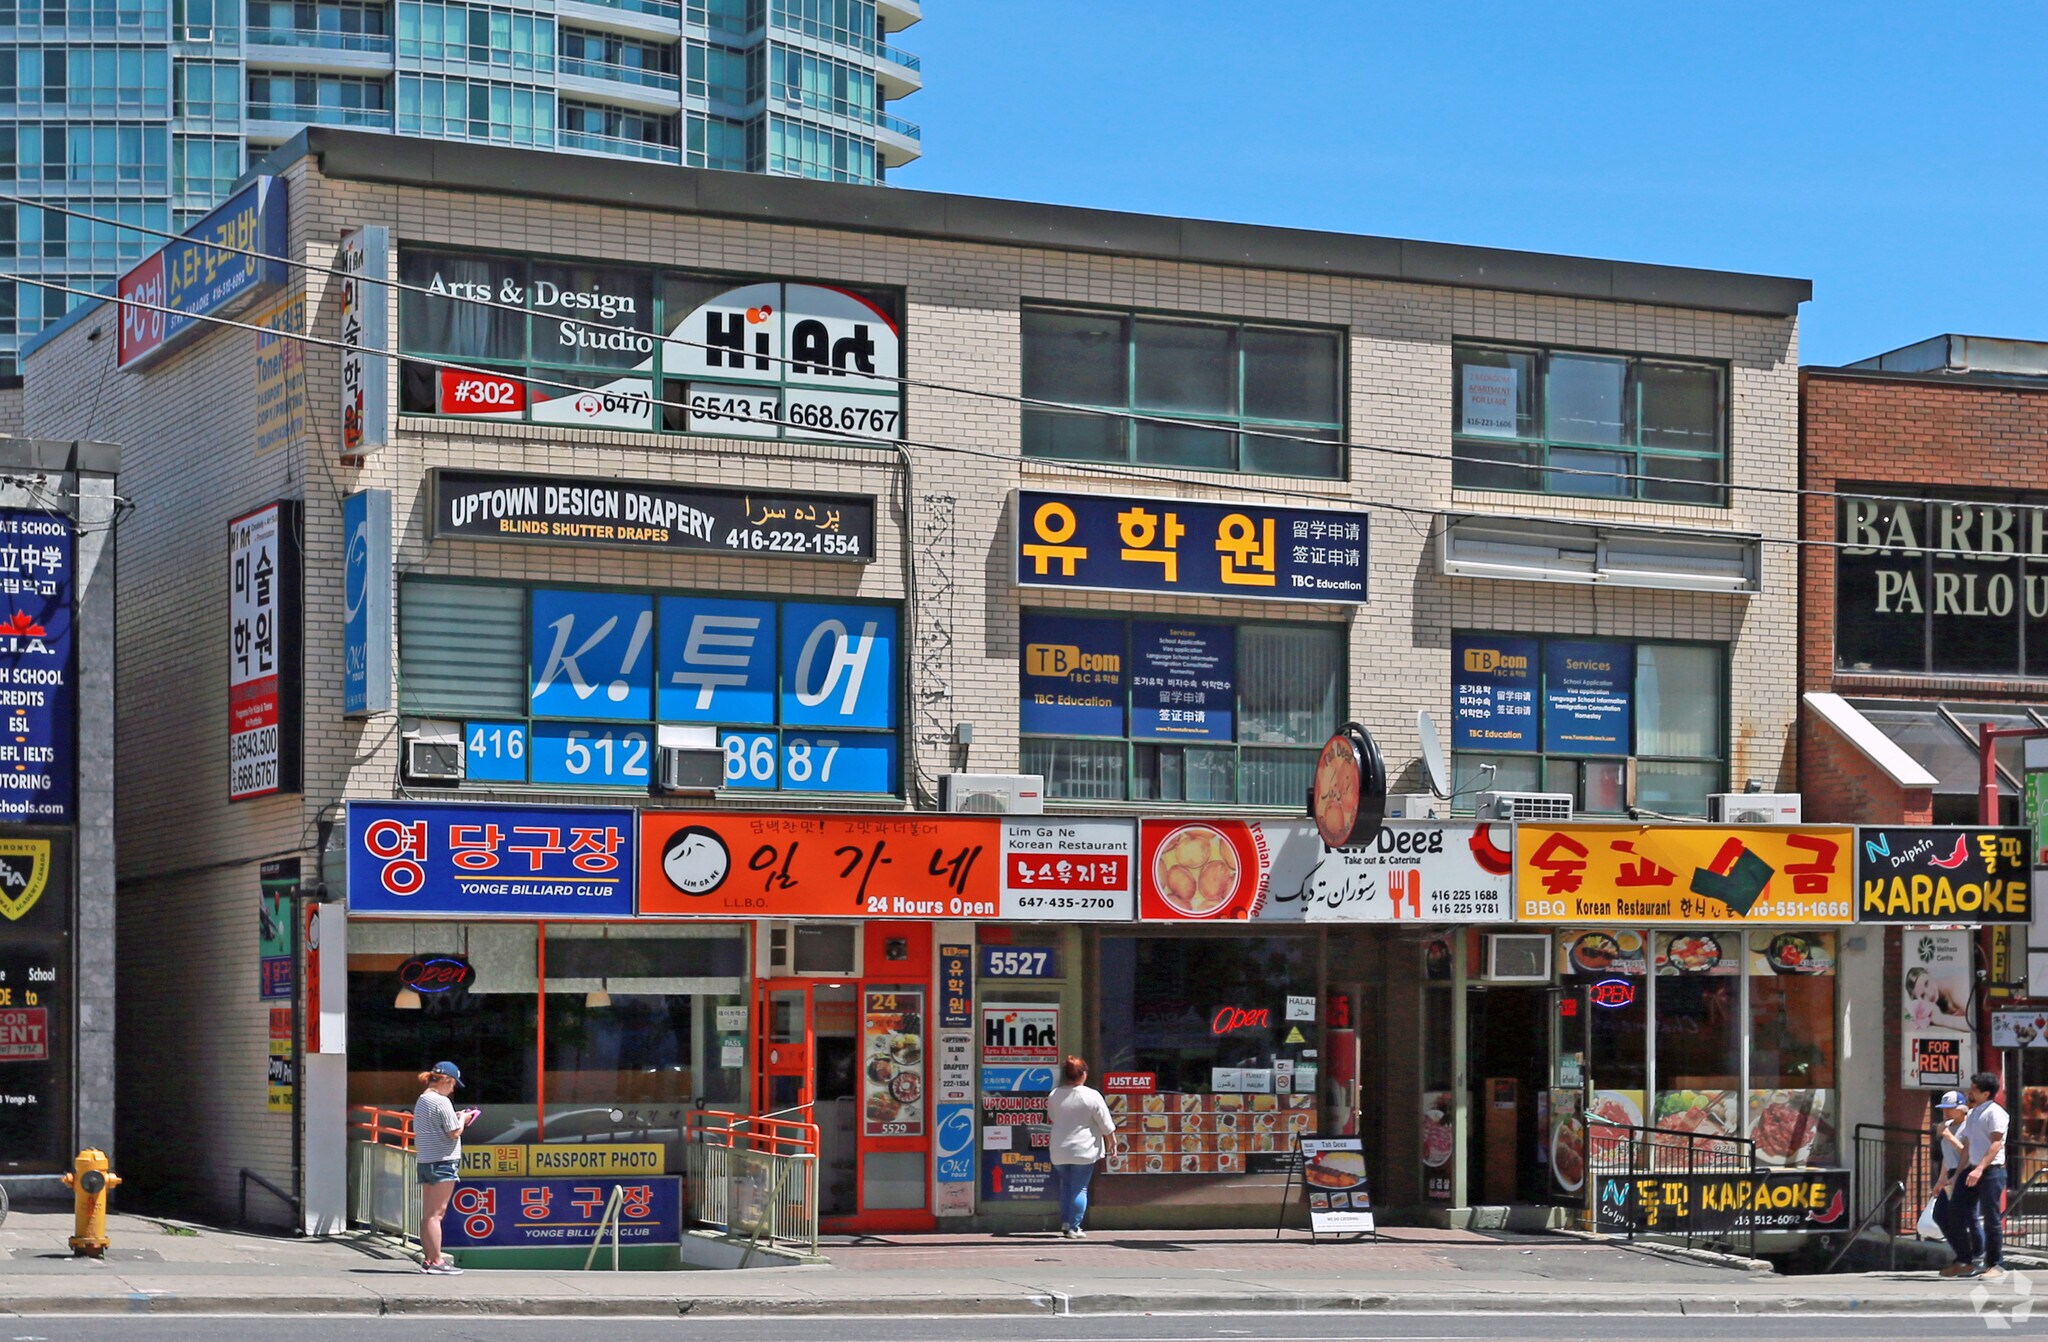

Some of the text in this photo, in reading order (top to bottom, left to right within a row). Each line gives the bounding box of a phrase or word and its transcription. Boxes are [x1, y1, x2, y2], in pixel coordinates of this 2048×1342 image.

[426, 272, 636, 320] Arts & Design
[558, 320, 653, 354] Studio
[706, 305, 874, 377] Hi Art
[454, 379, 515, 407] #302
[601, 390, 651, 420] 647)
[789, 402, 900, 434] 668.6767
[450, 486, 717, 544] UPTOWN DESIGN DRAPERY
[21, 522, 67, 537] SCHOOL
[500, 518, 669, 543] BLINDS SHUTTER DRAPES
[1292, 519, 1361, 541] 留学申请
[725, 528, 860, 556] 416-222-1554
[1292, 545, 1361, 567] 签证申请
[1290, 574, 1362, 591] TBC Education
[1566, 657, 1611, 673] Services
[13, 669, 64, 685] SCHOOL
[1563, 677, 1613, 688] School Application
[1034, 693, 1112, 708] TBC Education
[1159, 690, 1206, 705] 留学申请
[1549, 695, 1576, 705] Language
[1578, 696, 1596, 705] School
[1159, 708, 1206, 723] 签证申请
[1555, 703, 1621, 713] Immigration Consultation
[9, 716, 29, 732] ESL
[1574, 712, 1602, 721] Homestay
[1469, 729, 1522, 740] TBC Education
[24, 746, 54, 762] IELTS
[469, 727, 524, 760] 416
[565, 730, 649, 776] 512
[1009, 827, 1075, 839] Lim Ga Ne
[449, 824, 625, 873] 당구장
[1009, 840, 1128, 851] Korean Restaurant
[1376, 827, 1444, 857] Deeg
[1865, 832, 1934, 868] N Dolphin
[1344, 856, 1422, 868] Take out & Catering
[461, 883, 613, 897] YONGE BILLIARD CLUB
[1431, 890, 1499, 902] 416 225 1688
[1863, 874, 2027, 916] KARAOKE
[867, 897, 995, 918] 24 Hours Open
[1432, 903, 1499, 915] 416 225 9781
[1525, 899, 1671, 917] BBQ Korean Restaurant
[990, 951, 1047, 976] 5527
[29, 967, 56, 981] School
[400, 960, 469, 987] Open
[26, 989, 38, 1006] to
[872, 994, 897, 1010] 24
[1289, 997, 1316, 1006] HALAL
[1589, 986, 1635, 1003] OPEN
[1213, 1007, 1269, 1034] Open
[1023, 1023, 1056, 1046] Art
[1928, 1040, 1950, 1053] FOR
[944, 1063, 969, 1071] DRAPERY
[1919, 1054, 1959, 1074] RENT
[1108, 1076, 1151, 1087] JUST EAT
[5, 1095, 38, 1106] Yonge St.
[983, 1097, 1022, 1111] UPTOWN
[996, 1112, 1044, 1126] DRAPERY
[882, 1122, 907, 1134] 5529
[536, 1151, 658, 1168] PASSPORT PHOTO
[1702, 1180, 1828, 1213] KARAOKE
[1755, 1215, 1801, 1226] 512-6092
[525, 1228, 650, 1238] YONGE CLUB
